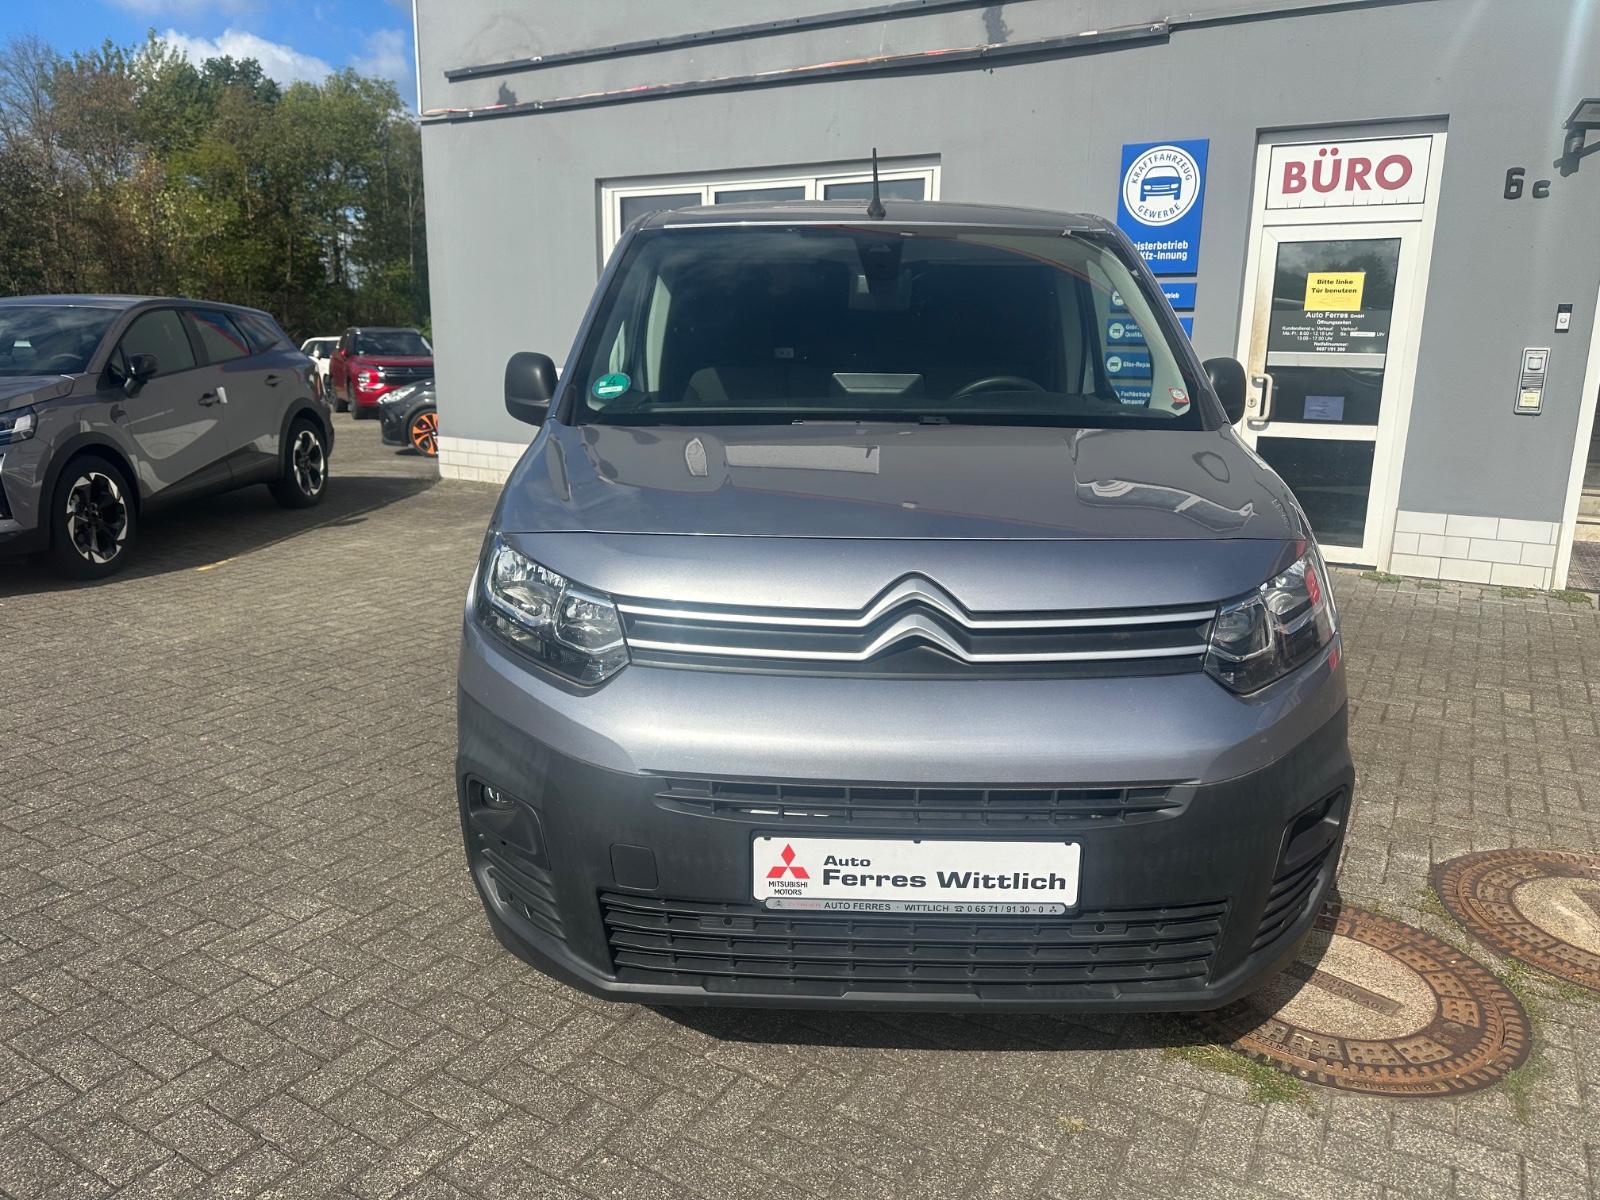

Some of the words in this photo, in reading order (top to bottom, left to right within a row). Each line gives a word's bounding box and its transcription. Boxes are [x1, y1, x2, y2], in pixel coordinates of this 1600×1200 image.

[1131, 153, 1193, 184] KRAFTFAHRZEUG
[1282, 147, 1413, 194] BÜRO
[1138, 203, 1181, 219] GEWERBE
[1133, 240, 1189, 251] isterbetrieb
[1140, 250, 1188, 261] Kfz-Innung
[606, 375, 617, 386] 4
[823, 855, 871, 867] Auto
[768, 880, 808, 888] MITSUBISHI
[822, 869, 927, 888] Ferres
[936, 871, 1066, 890] Wittlich
[824, 902, 850, 910] AUTO
[853, 902, 891, 911] FERRES
[904, 904, 949, 912] WITTLICH
[967, 905, 973, 913] 0
[975, 905, 986, 913] 65
